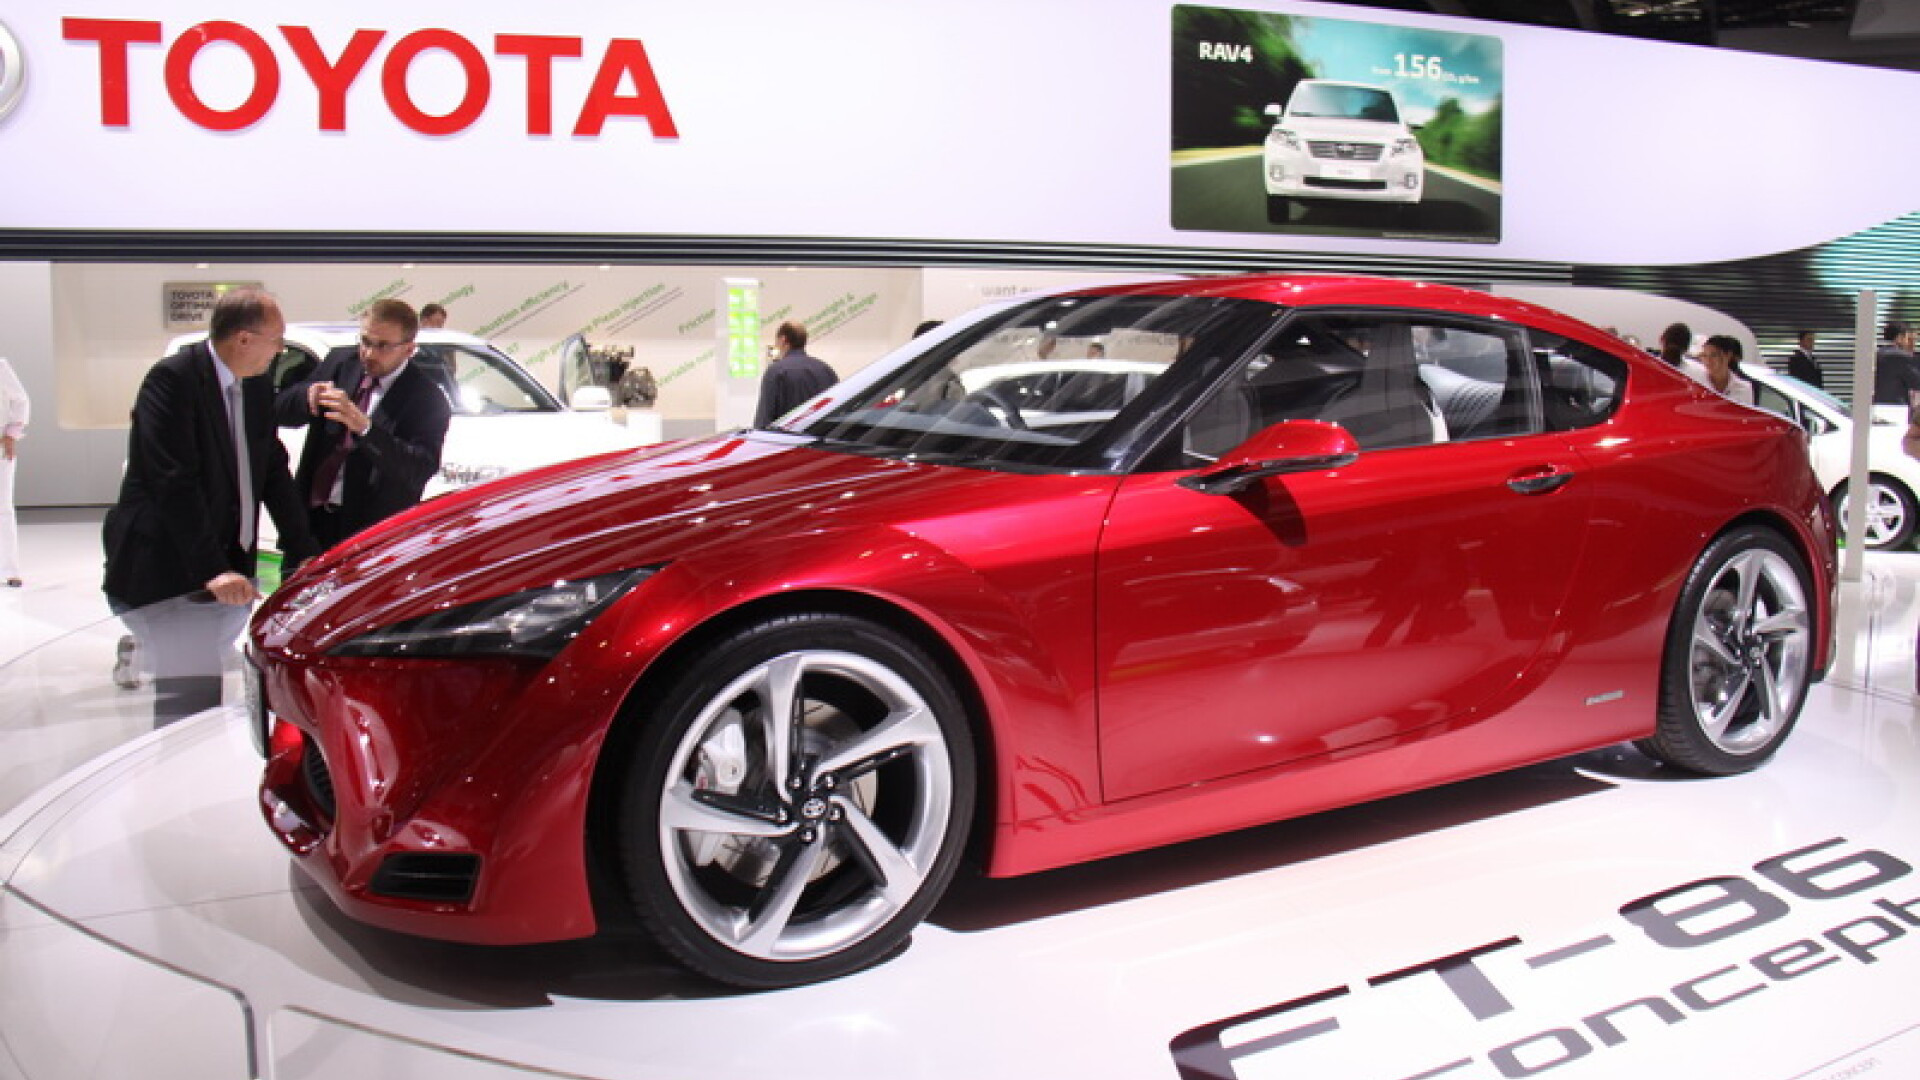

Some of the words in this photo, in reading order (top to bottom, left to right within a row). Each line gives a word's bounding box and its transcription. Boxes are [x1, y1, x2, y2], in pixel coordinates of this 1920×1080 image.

[1198, 39, 1254, 64] RAV4
[62, 17, 678, 138] TOYOTA
[1393, 52, 1441, 78] 156
[170, 301, 211, 310] OPTIMA
[171, 290, 215, 300] TOYOTA
[1168, 836, 1914, 1080] FT-86
